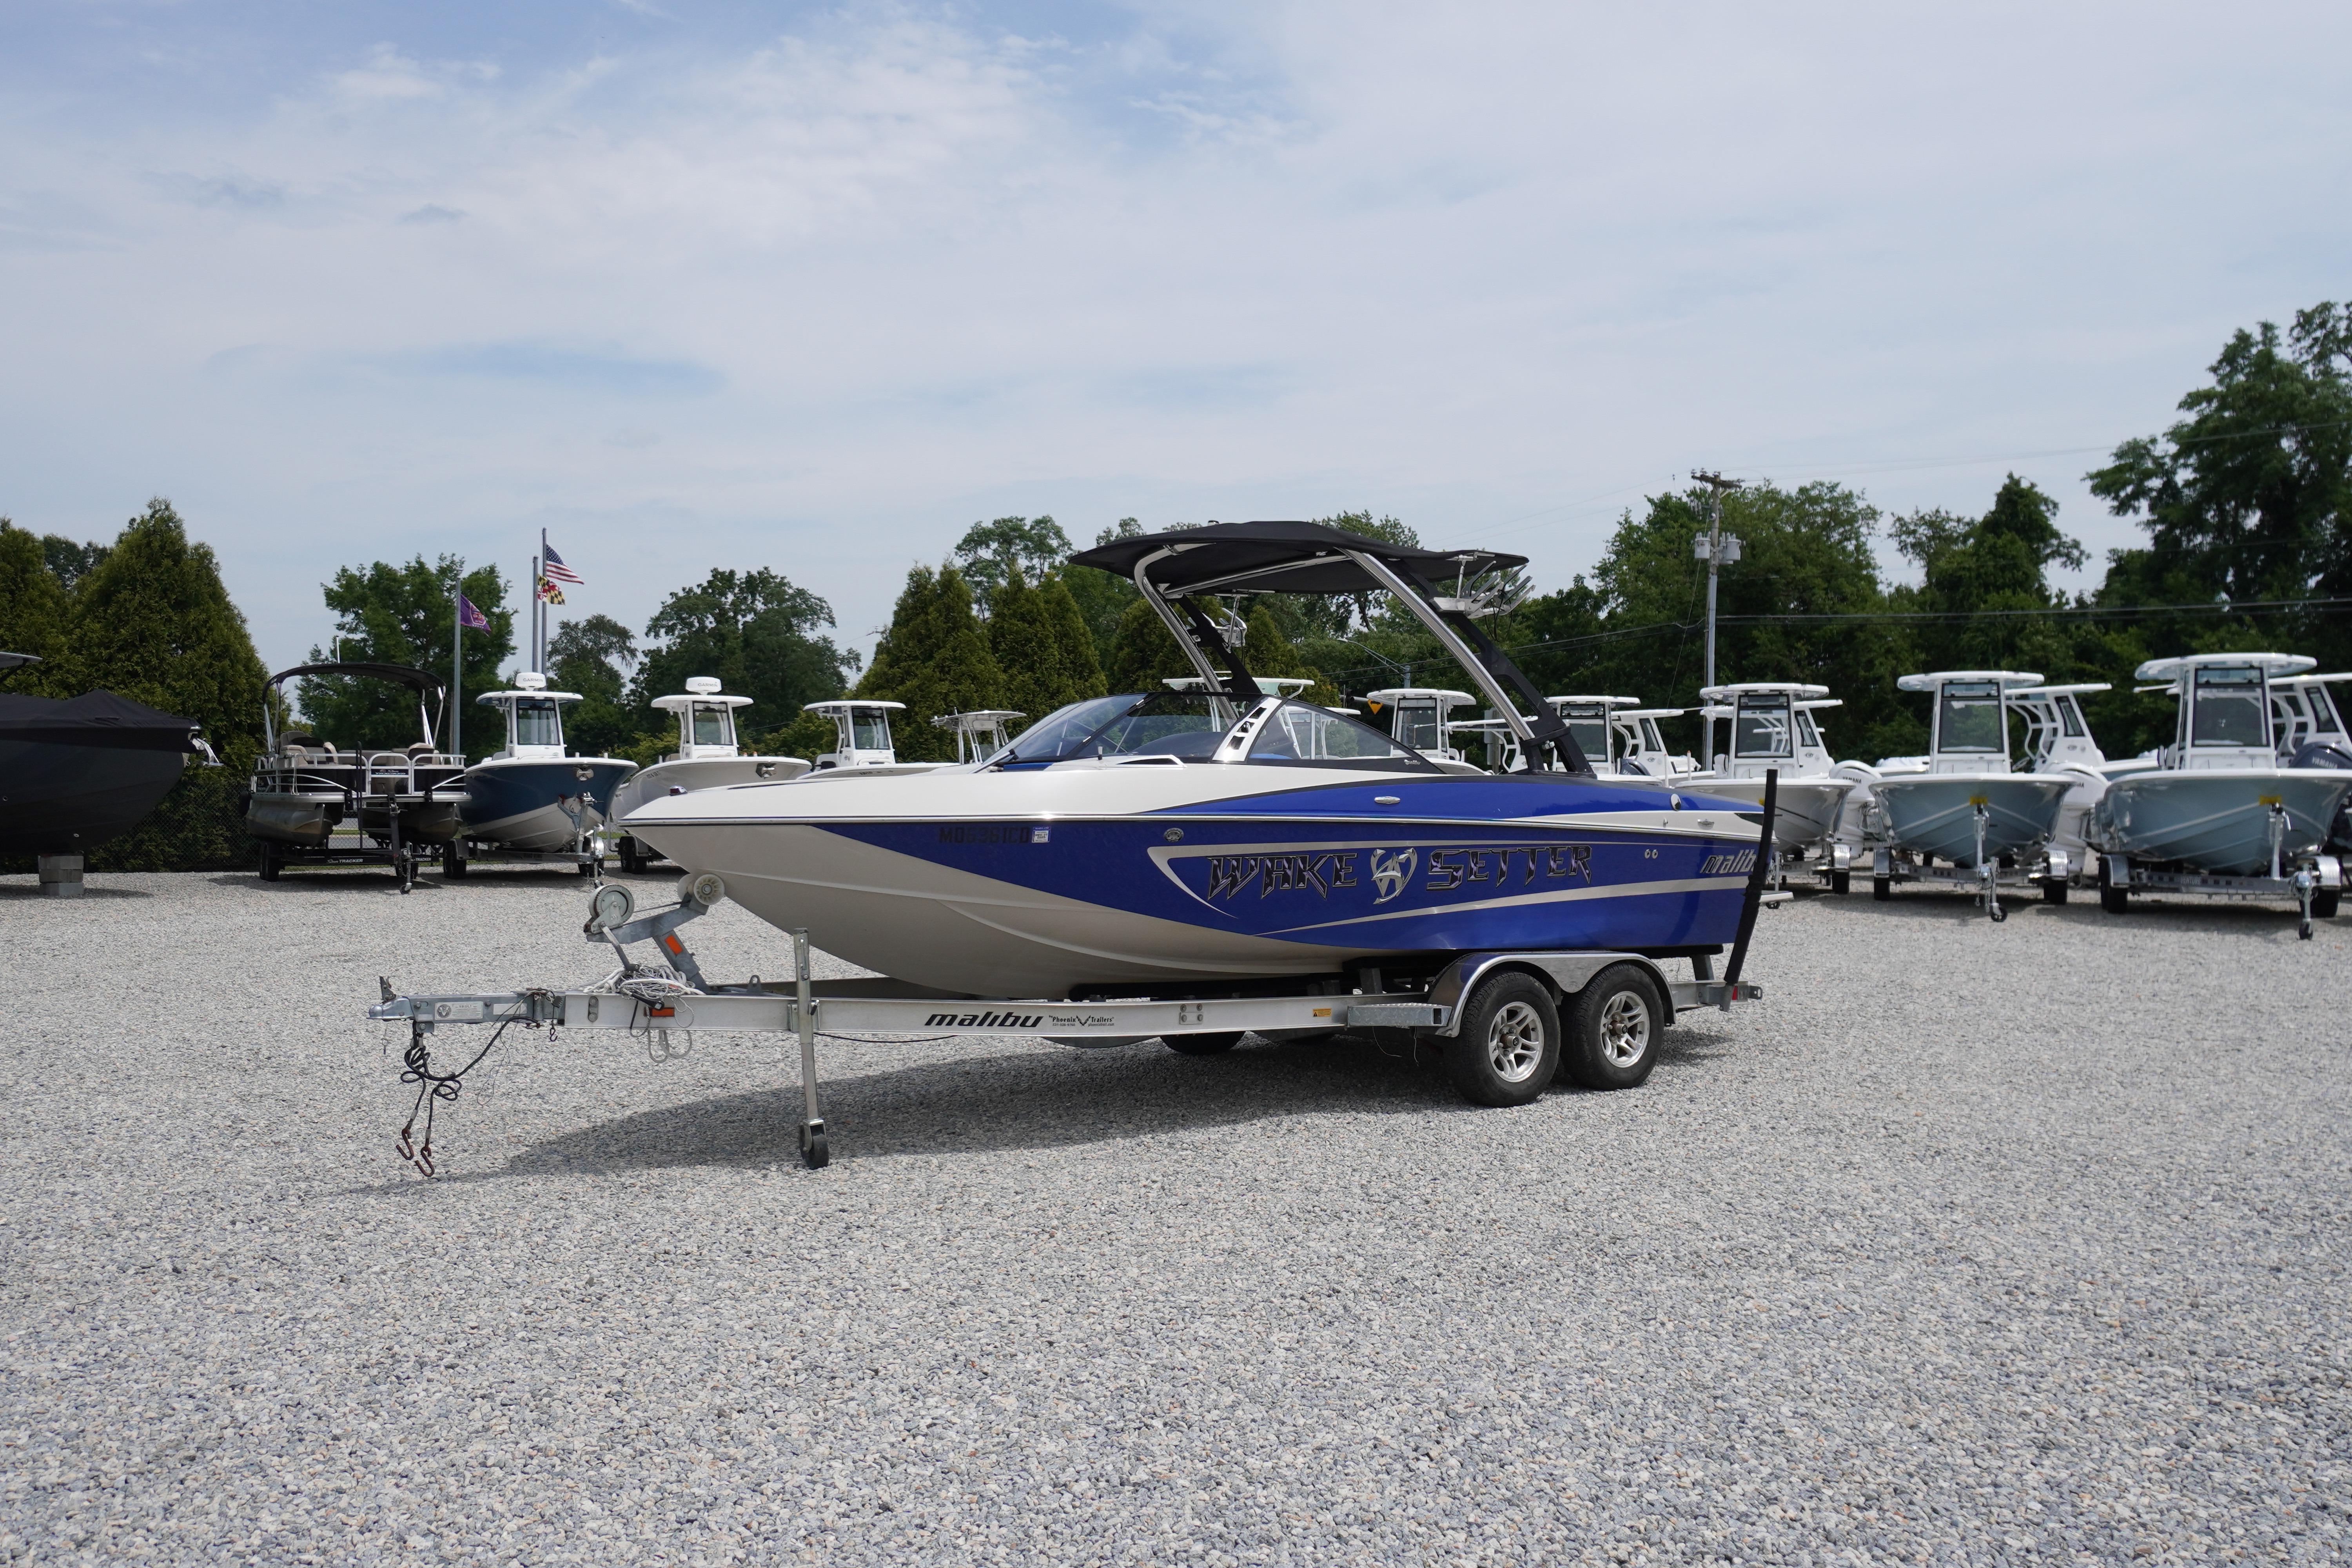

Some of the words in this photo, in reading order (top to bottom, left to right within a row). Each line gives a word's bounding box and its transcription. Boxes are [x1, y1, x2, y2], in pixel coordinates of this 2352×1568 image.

[1206, 853, 1358, 900] WAKE
[1426, 845, 1593, 891] SETTER
[1700, 849, 1757, 874] malib
[924, 1011, 1044, 1027] malibu
